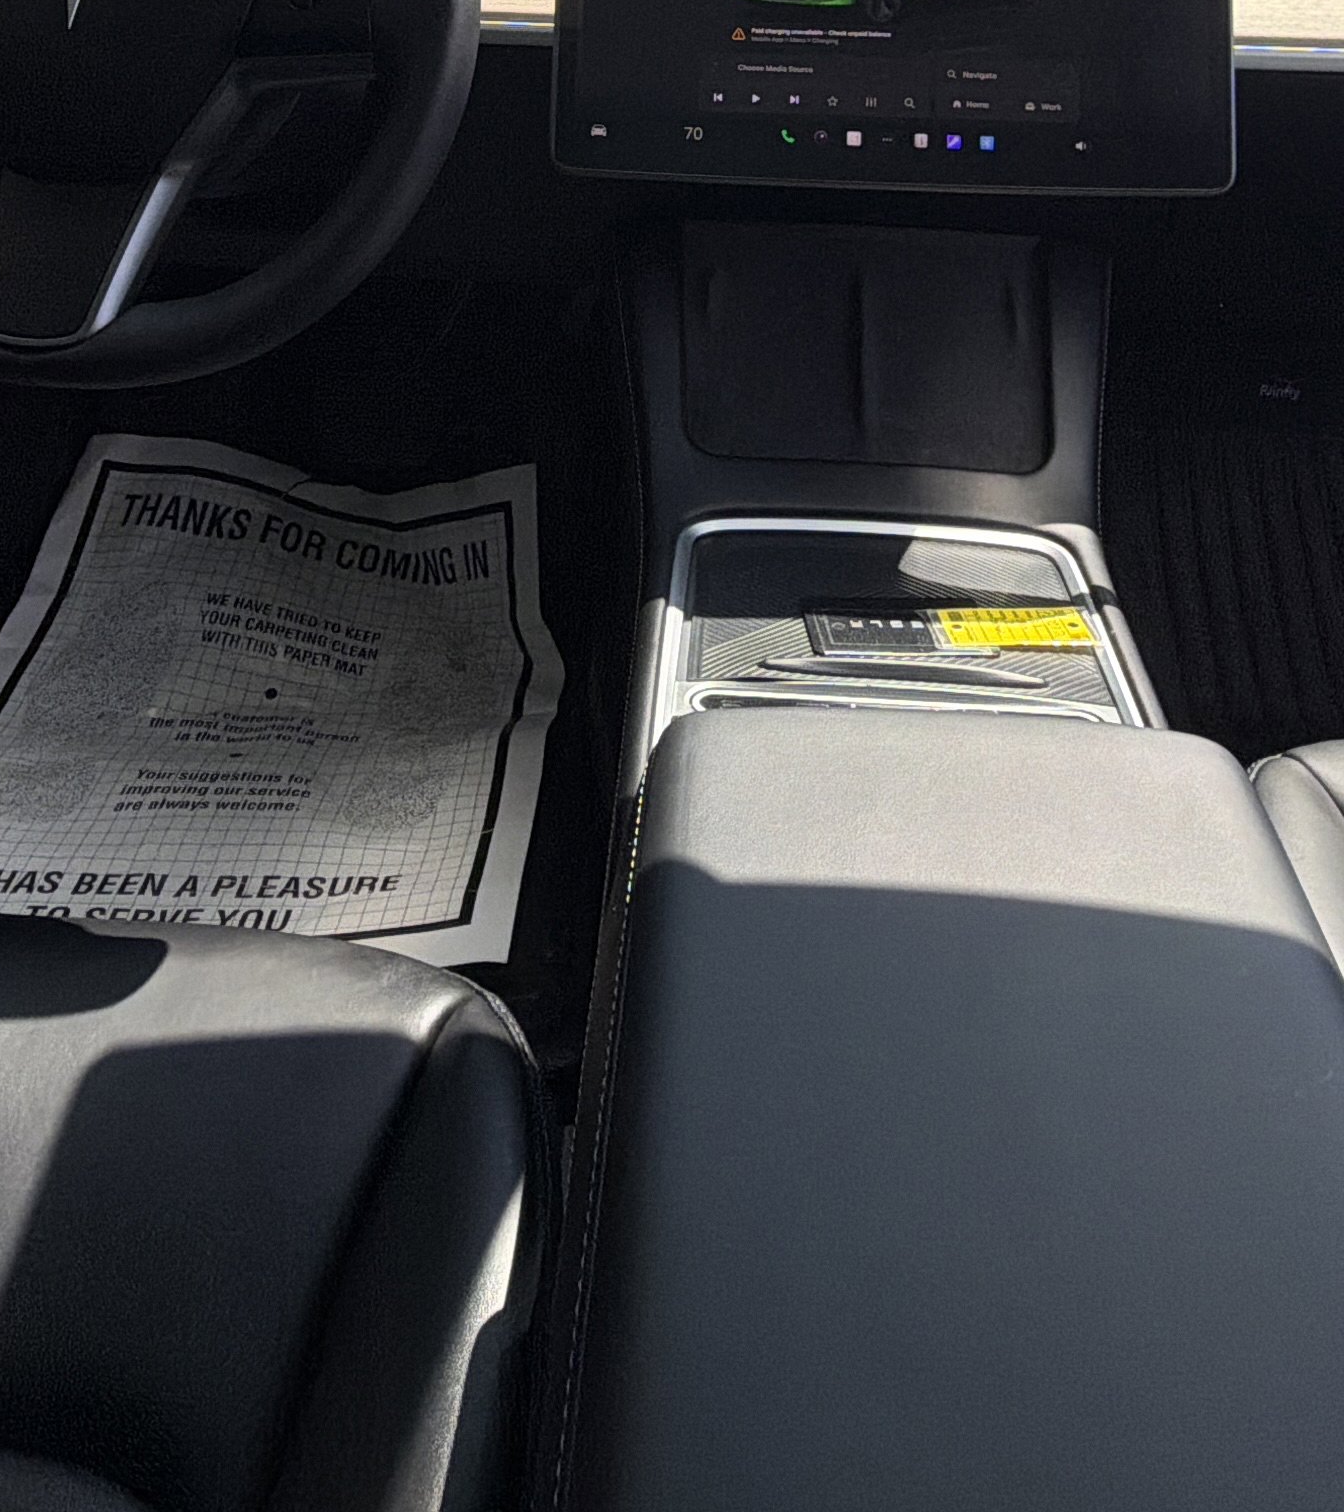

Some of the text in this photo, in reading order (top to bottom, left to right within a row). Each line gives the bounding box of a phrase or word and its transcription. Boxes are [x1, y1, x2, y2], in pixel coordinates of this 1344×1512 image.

[962, 71, 998, 80] Navigate
[966, 100, 990, 108] Home
[1040, 103, 1062, 111] Work
[683, 127, 704, 140] 70
[121, 493, 489, 586] THANKS FOR COMING IN
[206, 592, 382, 645] WE HAVE TRIED TO KEEP
[200, 609, 379, 661] YOUR CARPETING CLEAN
[200, 629, 367, 677] WITH THIS PAPER MAT
[149, 716, 361, 744] the most important person
[174, 731, 191, 742] in
[195, 732, 221, 743] the
[275, 733, 293, 743] to
[136, 768, 313, 786] Your suggestions for
[120, 784, 312, 799] improving our service
[112, 798, 301, 812] are always welcome.
[70, 872, 171, 897] BEEN
[179, 874, 202, 898] A
[210, 873, 404, 900] PLEASURE
[218, 909, 293, 932] YOU
